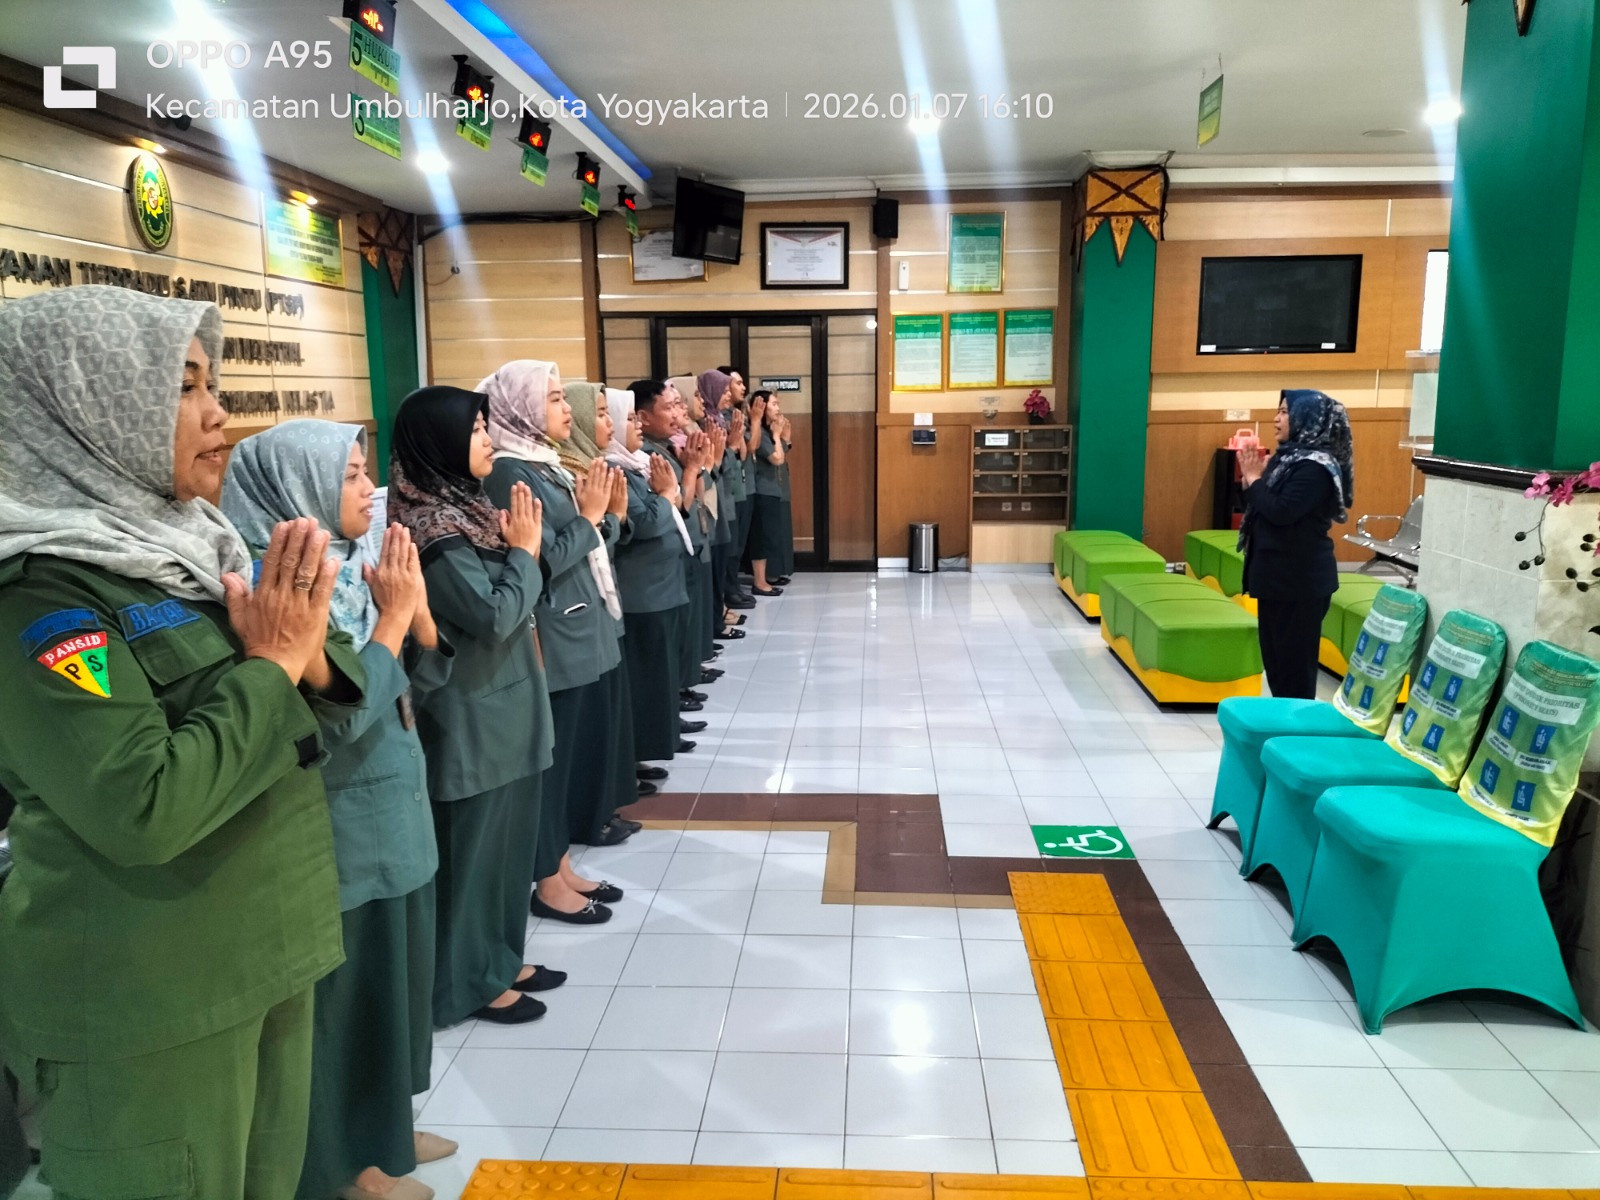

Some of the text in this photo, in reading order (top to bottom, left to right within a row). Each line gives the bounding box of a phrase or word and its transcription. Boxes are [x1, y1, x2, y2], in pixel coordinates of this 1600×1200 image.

[352, 30, 399, 74] 5 HUKUM
[45, 634, 101, 665] PANSID
[64, 654, 104, 681] P S
